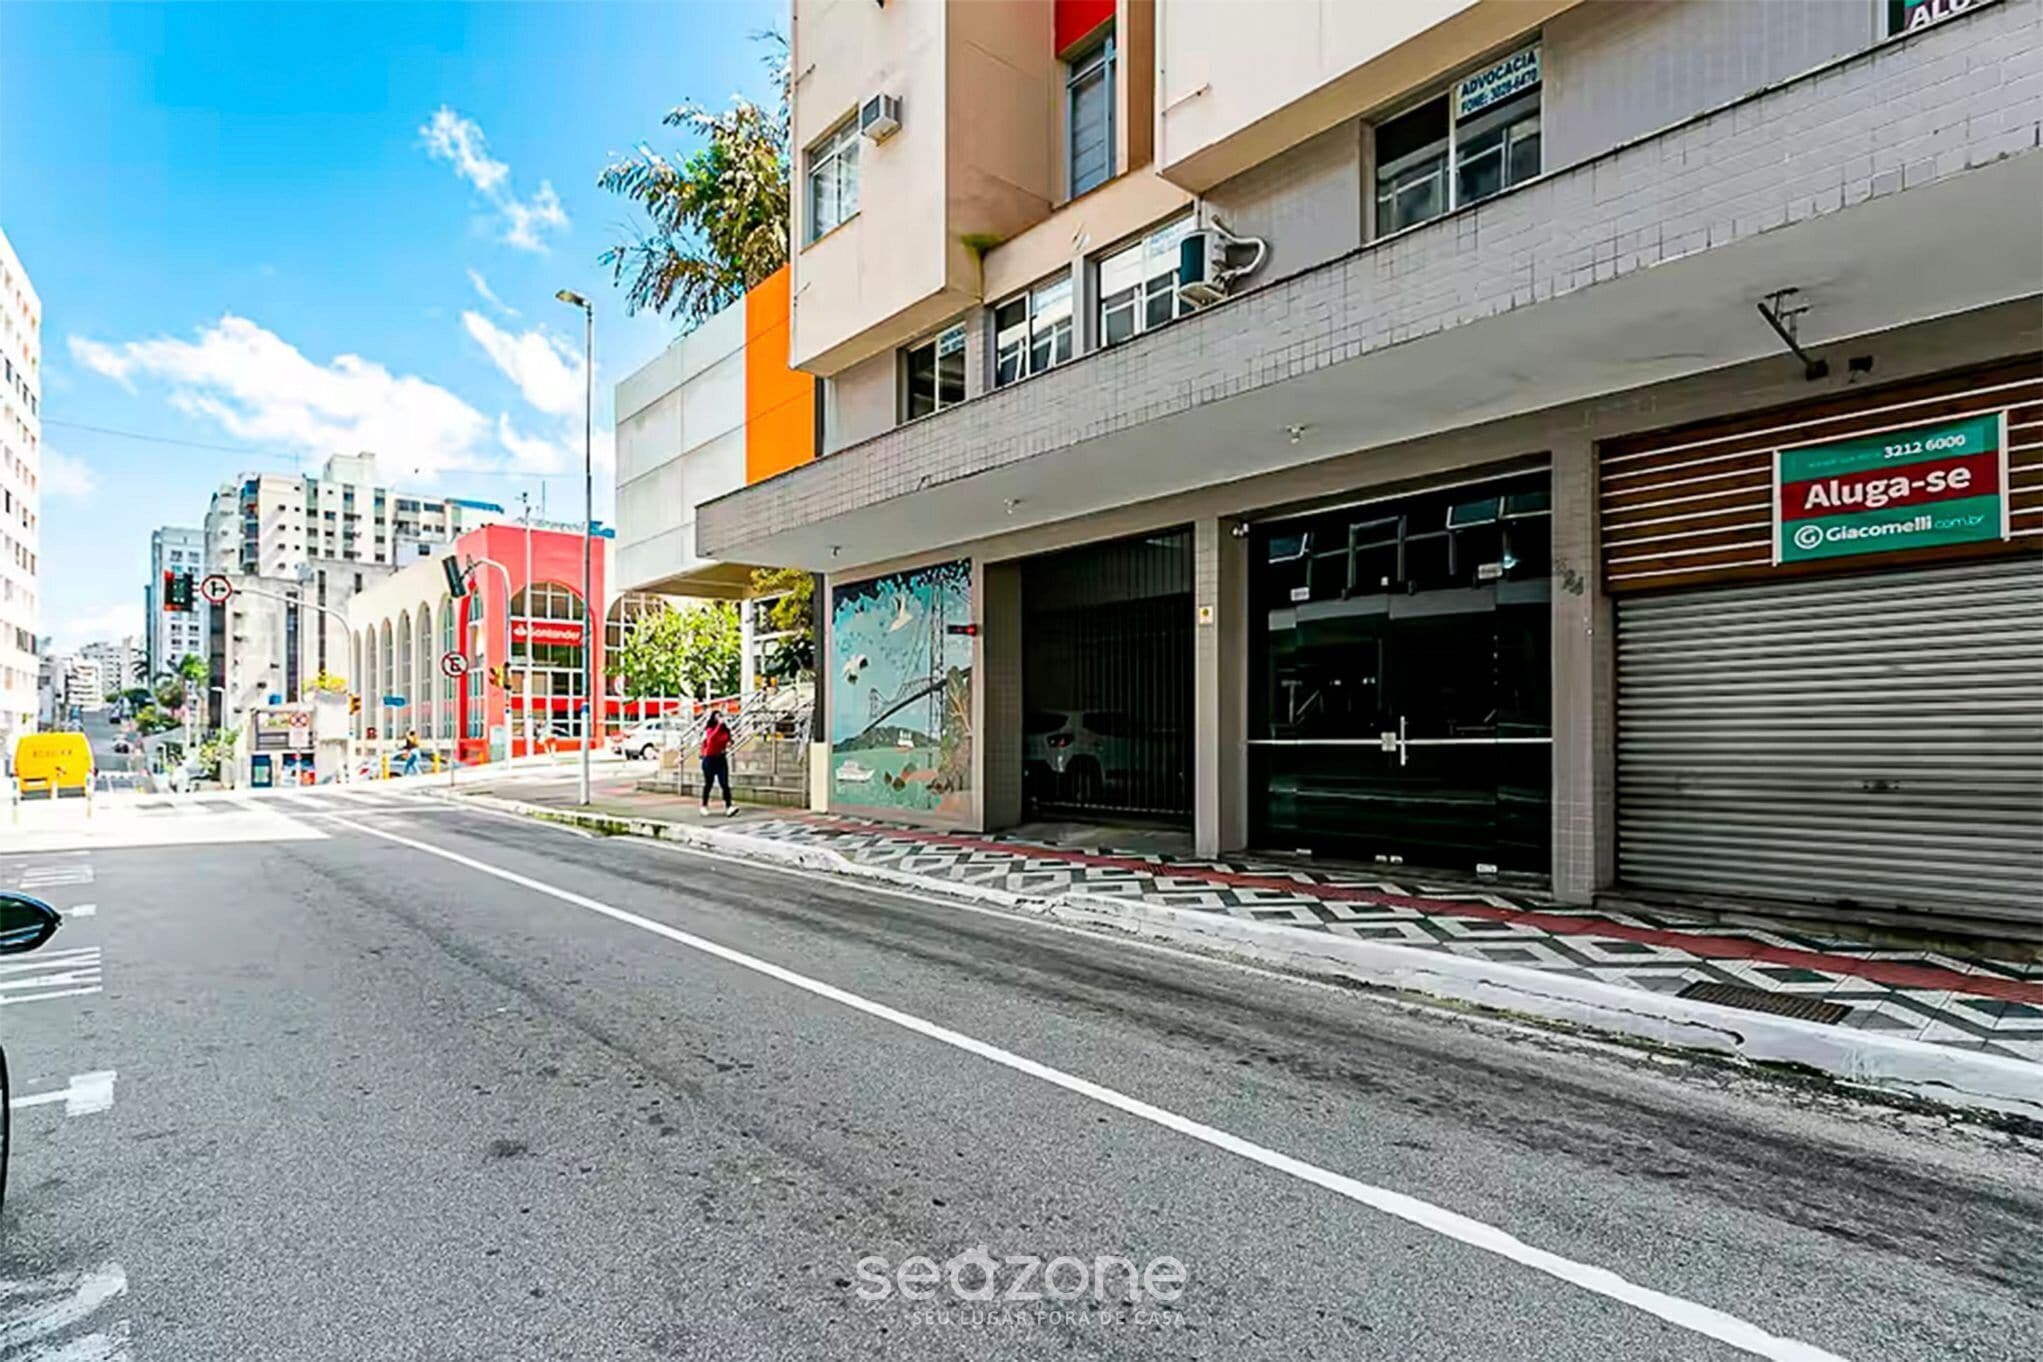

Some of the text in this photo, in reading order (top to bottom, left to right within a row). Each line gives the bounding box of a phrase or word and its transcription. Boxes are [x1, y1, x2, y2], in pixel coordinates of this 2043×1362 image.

[1460, 50, 1536, 98] ADVOCACIA
[1884, 434, 1966, 458] 3212 6000
[1804, 466, 1972, 510] Aluga-se
